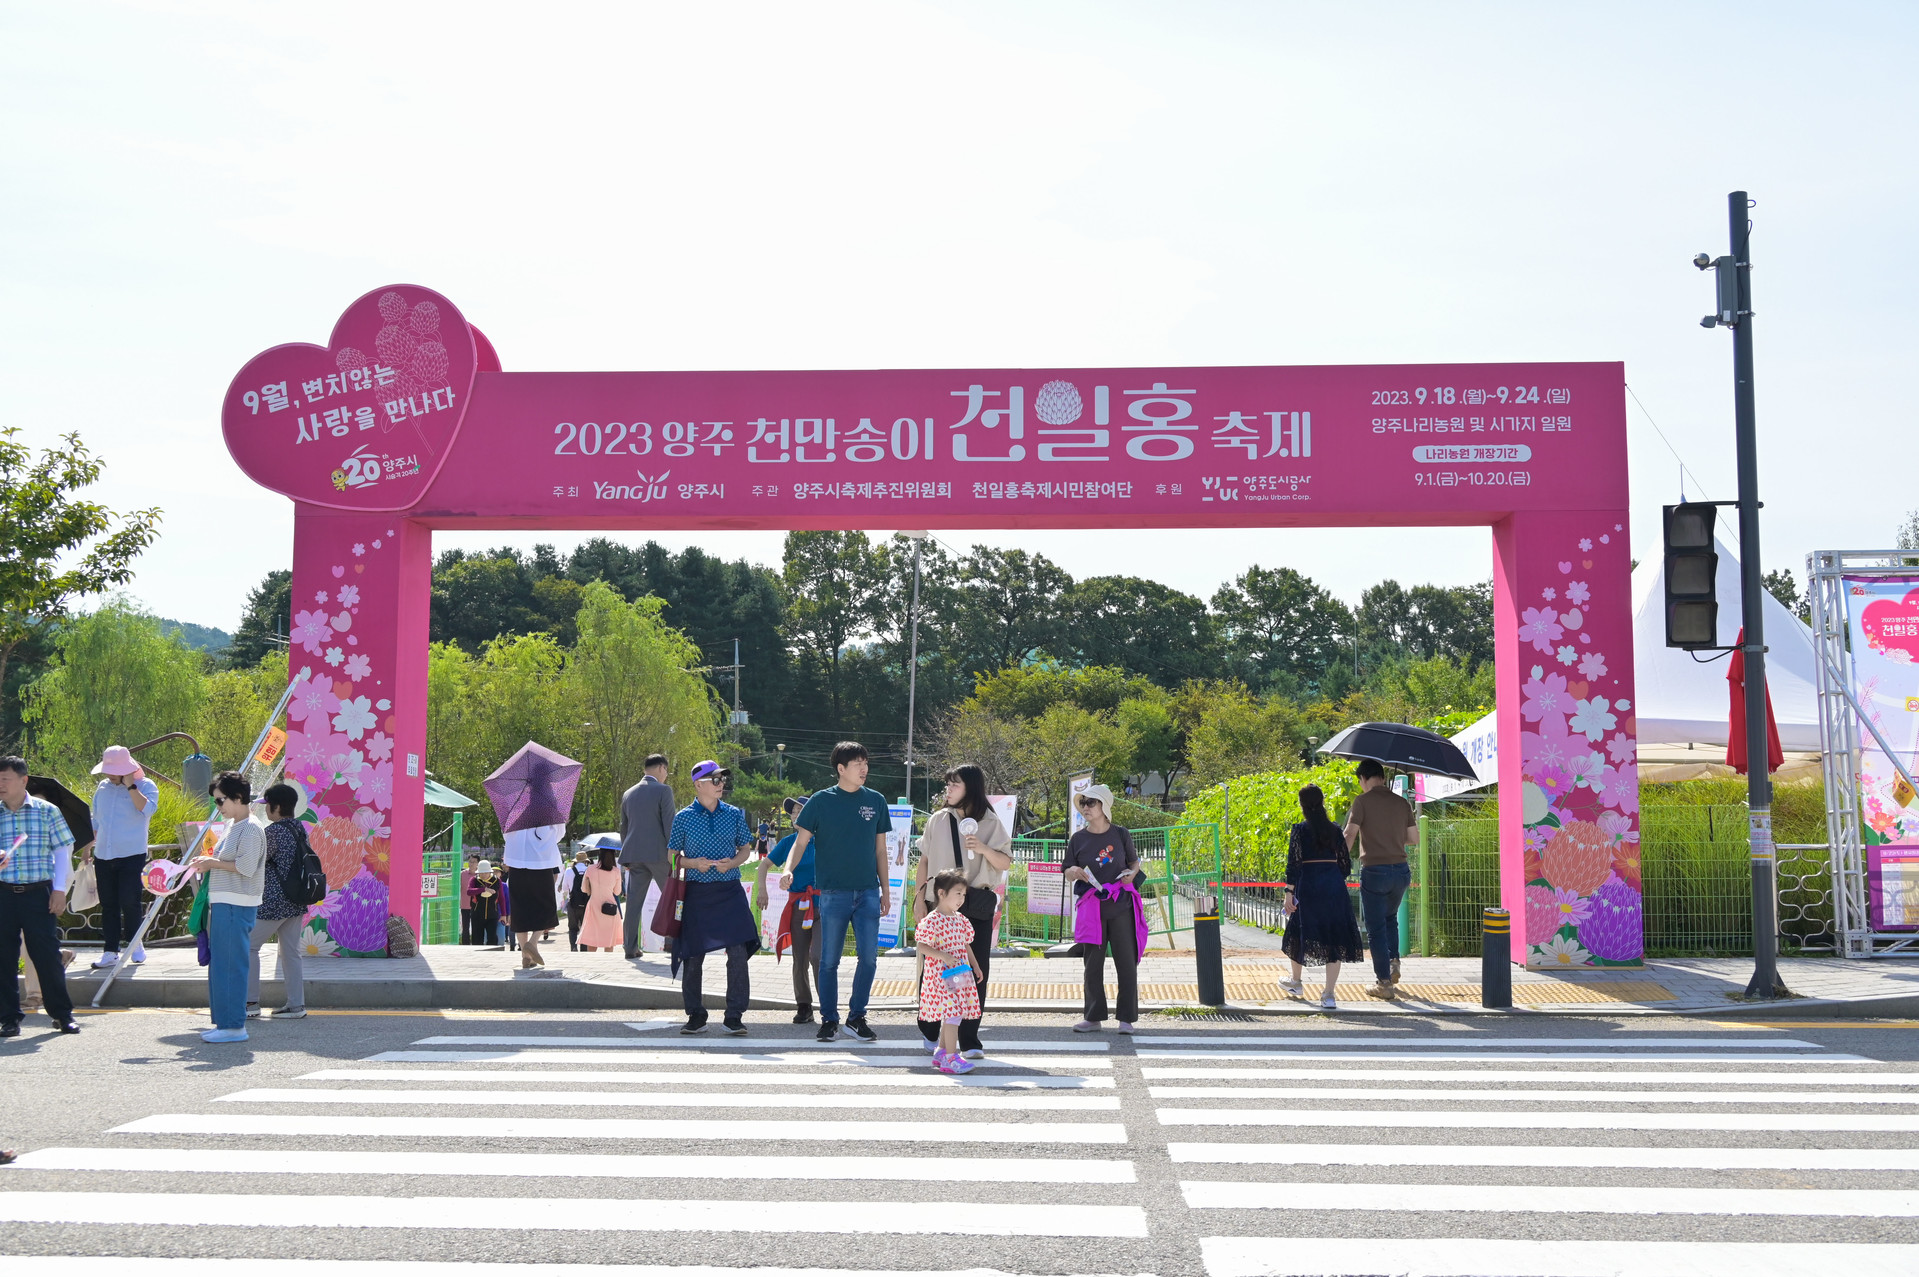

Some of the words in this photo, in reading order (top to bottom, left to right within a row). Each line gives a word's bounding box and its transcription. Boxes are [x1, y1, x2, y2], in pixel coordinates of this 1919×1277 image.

[243, 381, 300, 415] 9월,
[302, 364, 395, 403] 변치않는
[296, 406, 376, 444] 사랑을
[385, 386, 456, 423] 만나다
[555, 423, 652, 455] 2023
[662, 422, 735, 456] 양주
[747, 418, 933, 462] 천만송이
[950, 380, 1198, 461] 천일홍
[1211, 412, 1312, 460] 축제
[1372, 417, 1465, 433] 양주나리농원
[1470, 417, 1485, 432] 및
[1490, 416, 1536, 432] 시가지
[1541, 416, 1572, 432] 일원
[1426, 449, 1470, 459] 나리농원
[1474, 448, 1519, 459] 개장기간
[382, 454, 418, 473] 양주시
[1243, 475, 1312, 491] 양주도시공사
[1415, 472, 1531, 486] 9.1.(금)~10.20.(금)
[553, 486, 579, 497] 주최
[678, 484, 724, 499] 양주시
[752, 486, 778, 497] 주관
[794, 482, 952, 499] 양주시축제추진위원회
[972, 481, 1133, 498] 천일홍축제시민참여단
[1155, 484, 1182, 495] 후원
[1882, 624, 1918, 636] 천일홍
